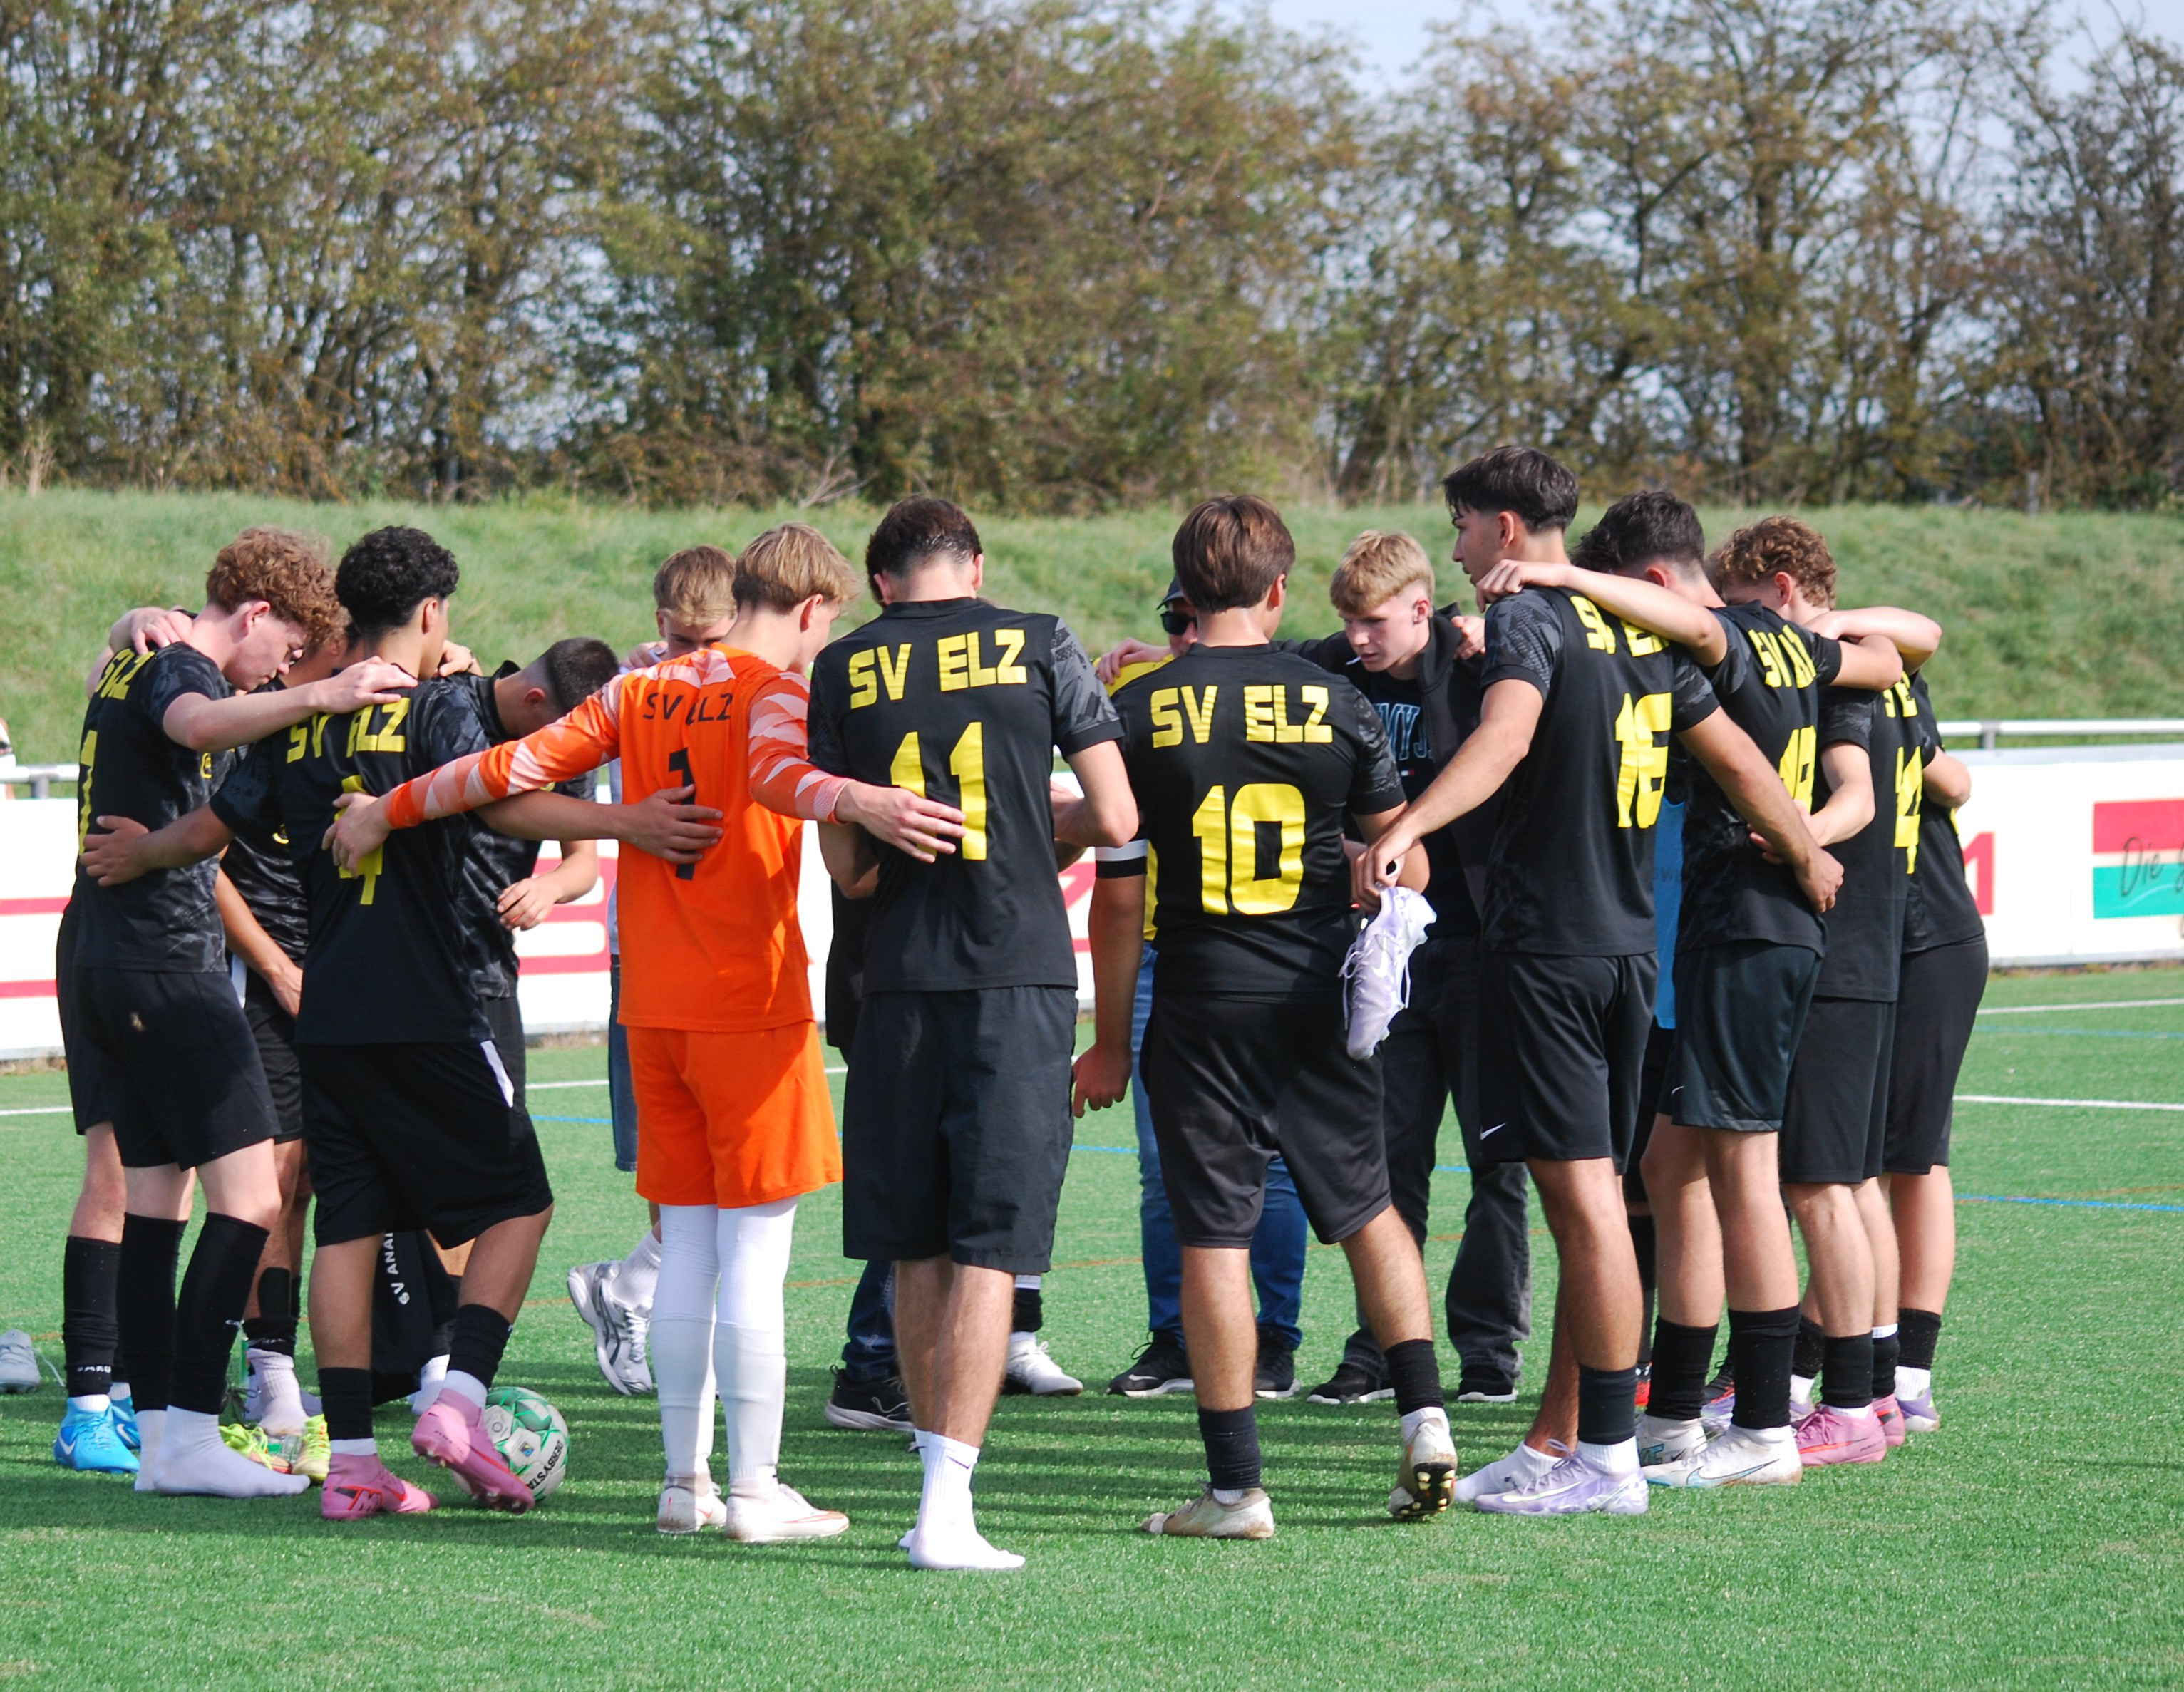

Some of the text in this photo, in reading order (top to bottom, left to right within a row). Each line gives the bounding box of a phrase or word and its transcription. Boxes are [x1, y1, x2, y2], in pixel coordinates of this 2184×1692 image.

[643, 692, 684, 721] SV
[849, 629, 1027, 709] SV ELZ
[287, 711, 334, 763] SV
[1150, 685, 1333, 748] SV ELZ
[890, 721, 987, 860] 11
[1615, 692, 1672, 829] 16
[668, 747, 696, 881] 1
[1192, 783, 1306, 915] 10
[525, 1440, 564, 1490] DERBYSTA
